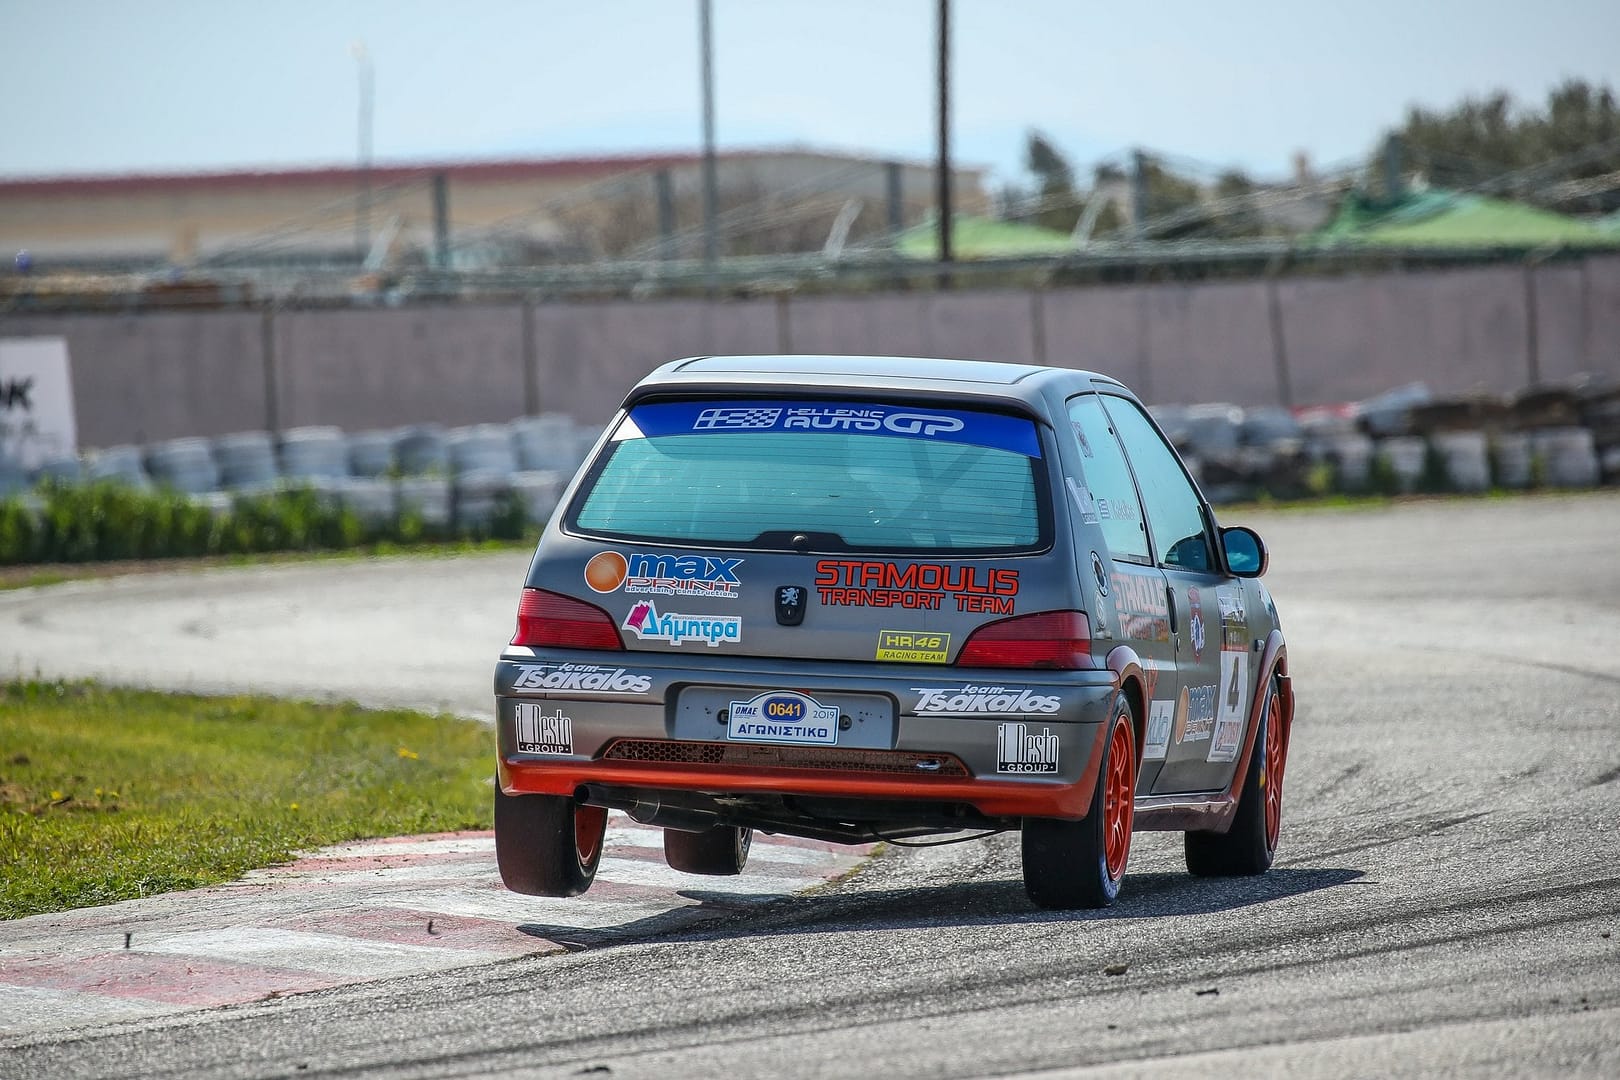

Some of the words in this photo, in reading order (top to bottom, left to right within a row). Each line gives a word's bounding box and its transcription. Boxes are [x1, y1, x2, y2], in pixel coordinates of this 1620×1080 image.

[786, 408, 885, 418] HELLENIC
[628, 553, 745, 583] max
[626, 576, 740, 592] PRINT
[815, 559, 1019, 596] STAMOULIS
[625, 585, 675, 596] advertising
[676, 588, 739, 599] constructions
[817, 588, 946, 611] TRANSPORT
[953, 593, 1015, 616] TEAM
[641, 606, 739, 643] Δήμητρα
[885, 635, 913, 647] HR
[915, 637, 942, 649] 46
[882, 650, 918, 660] RACING
[920, 652, 945, 661] TEAM
[557, 662, 600, 673] team
[512, 664, 653, 692] Tsakalos
[1227, 655, 1240, 713] 4
[960, 683, 1005, 694] team
[911, 687, 1061, 713] Tsakalos
[768, 702, 802, 717] 0641
[813, 710, 836, 720] 2019
[737, 723, 829, 738] ΑΓΩΝΙΣΤΙΚΟ
[526, 743, 565, 754] GROUP
[1006, 763, 1050, 773] GROUP
